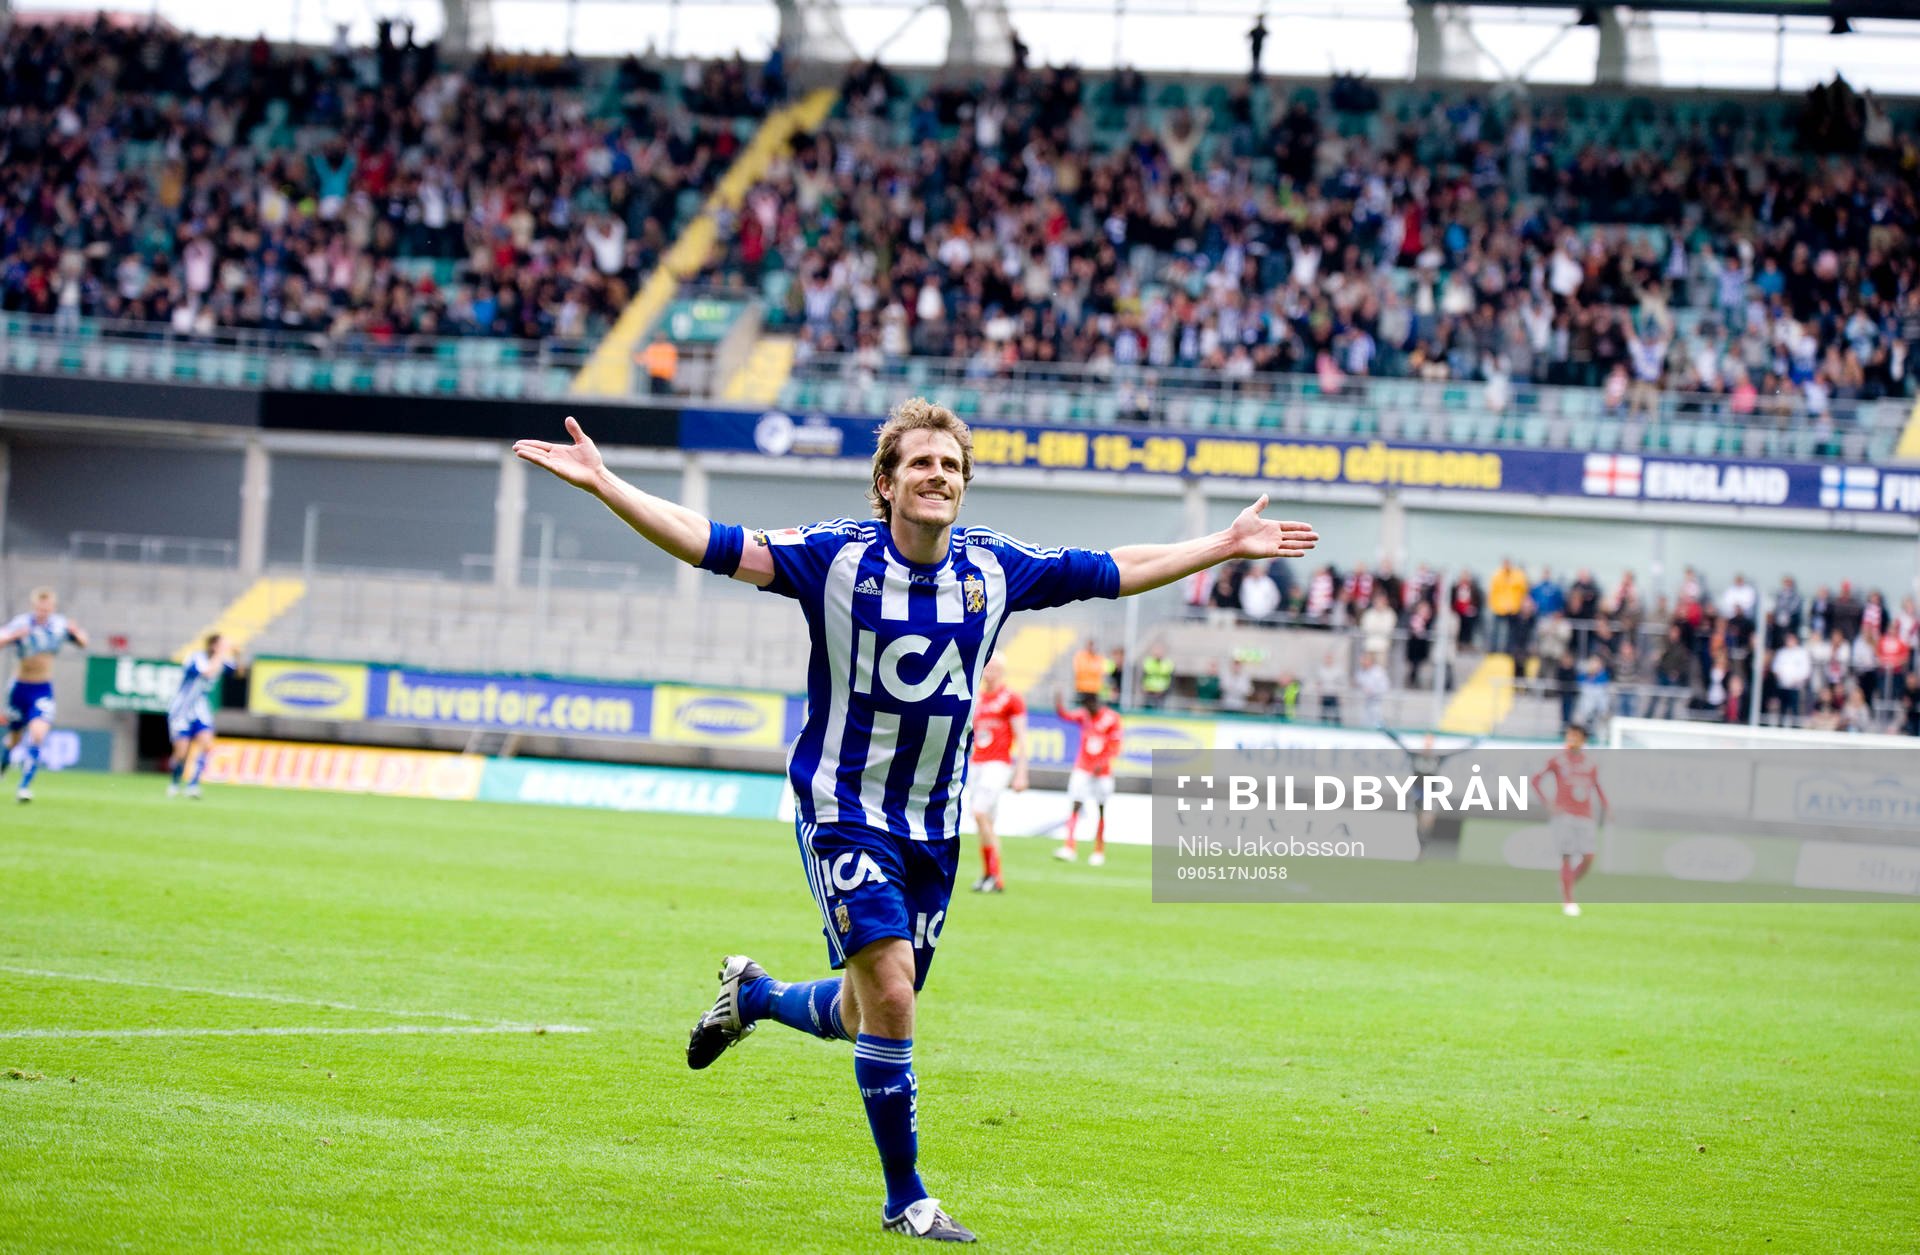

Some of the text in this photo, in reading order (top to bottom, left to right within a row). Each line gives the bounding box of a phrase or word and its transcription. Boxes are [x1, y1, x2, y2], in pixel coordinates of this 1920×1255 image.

[1187, 438, 1260, 478] JUNI
[1263, 443, 1341, 482] 2009
[1344, 441, 1502, 490] GÖTEBORG
[1644, 460, 1789, 505] ENGLAND
[854, 585, 882, 596] adidas
[854, 629, 972, 703] ICA
[386, 670, 634, 733] havator.com
[821, 849, 888, 897] ICA
[914, 910, 944, 949] IC
